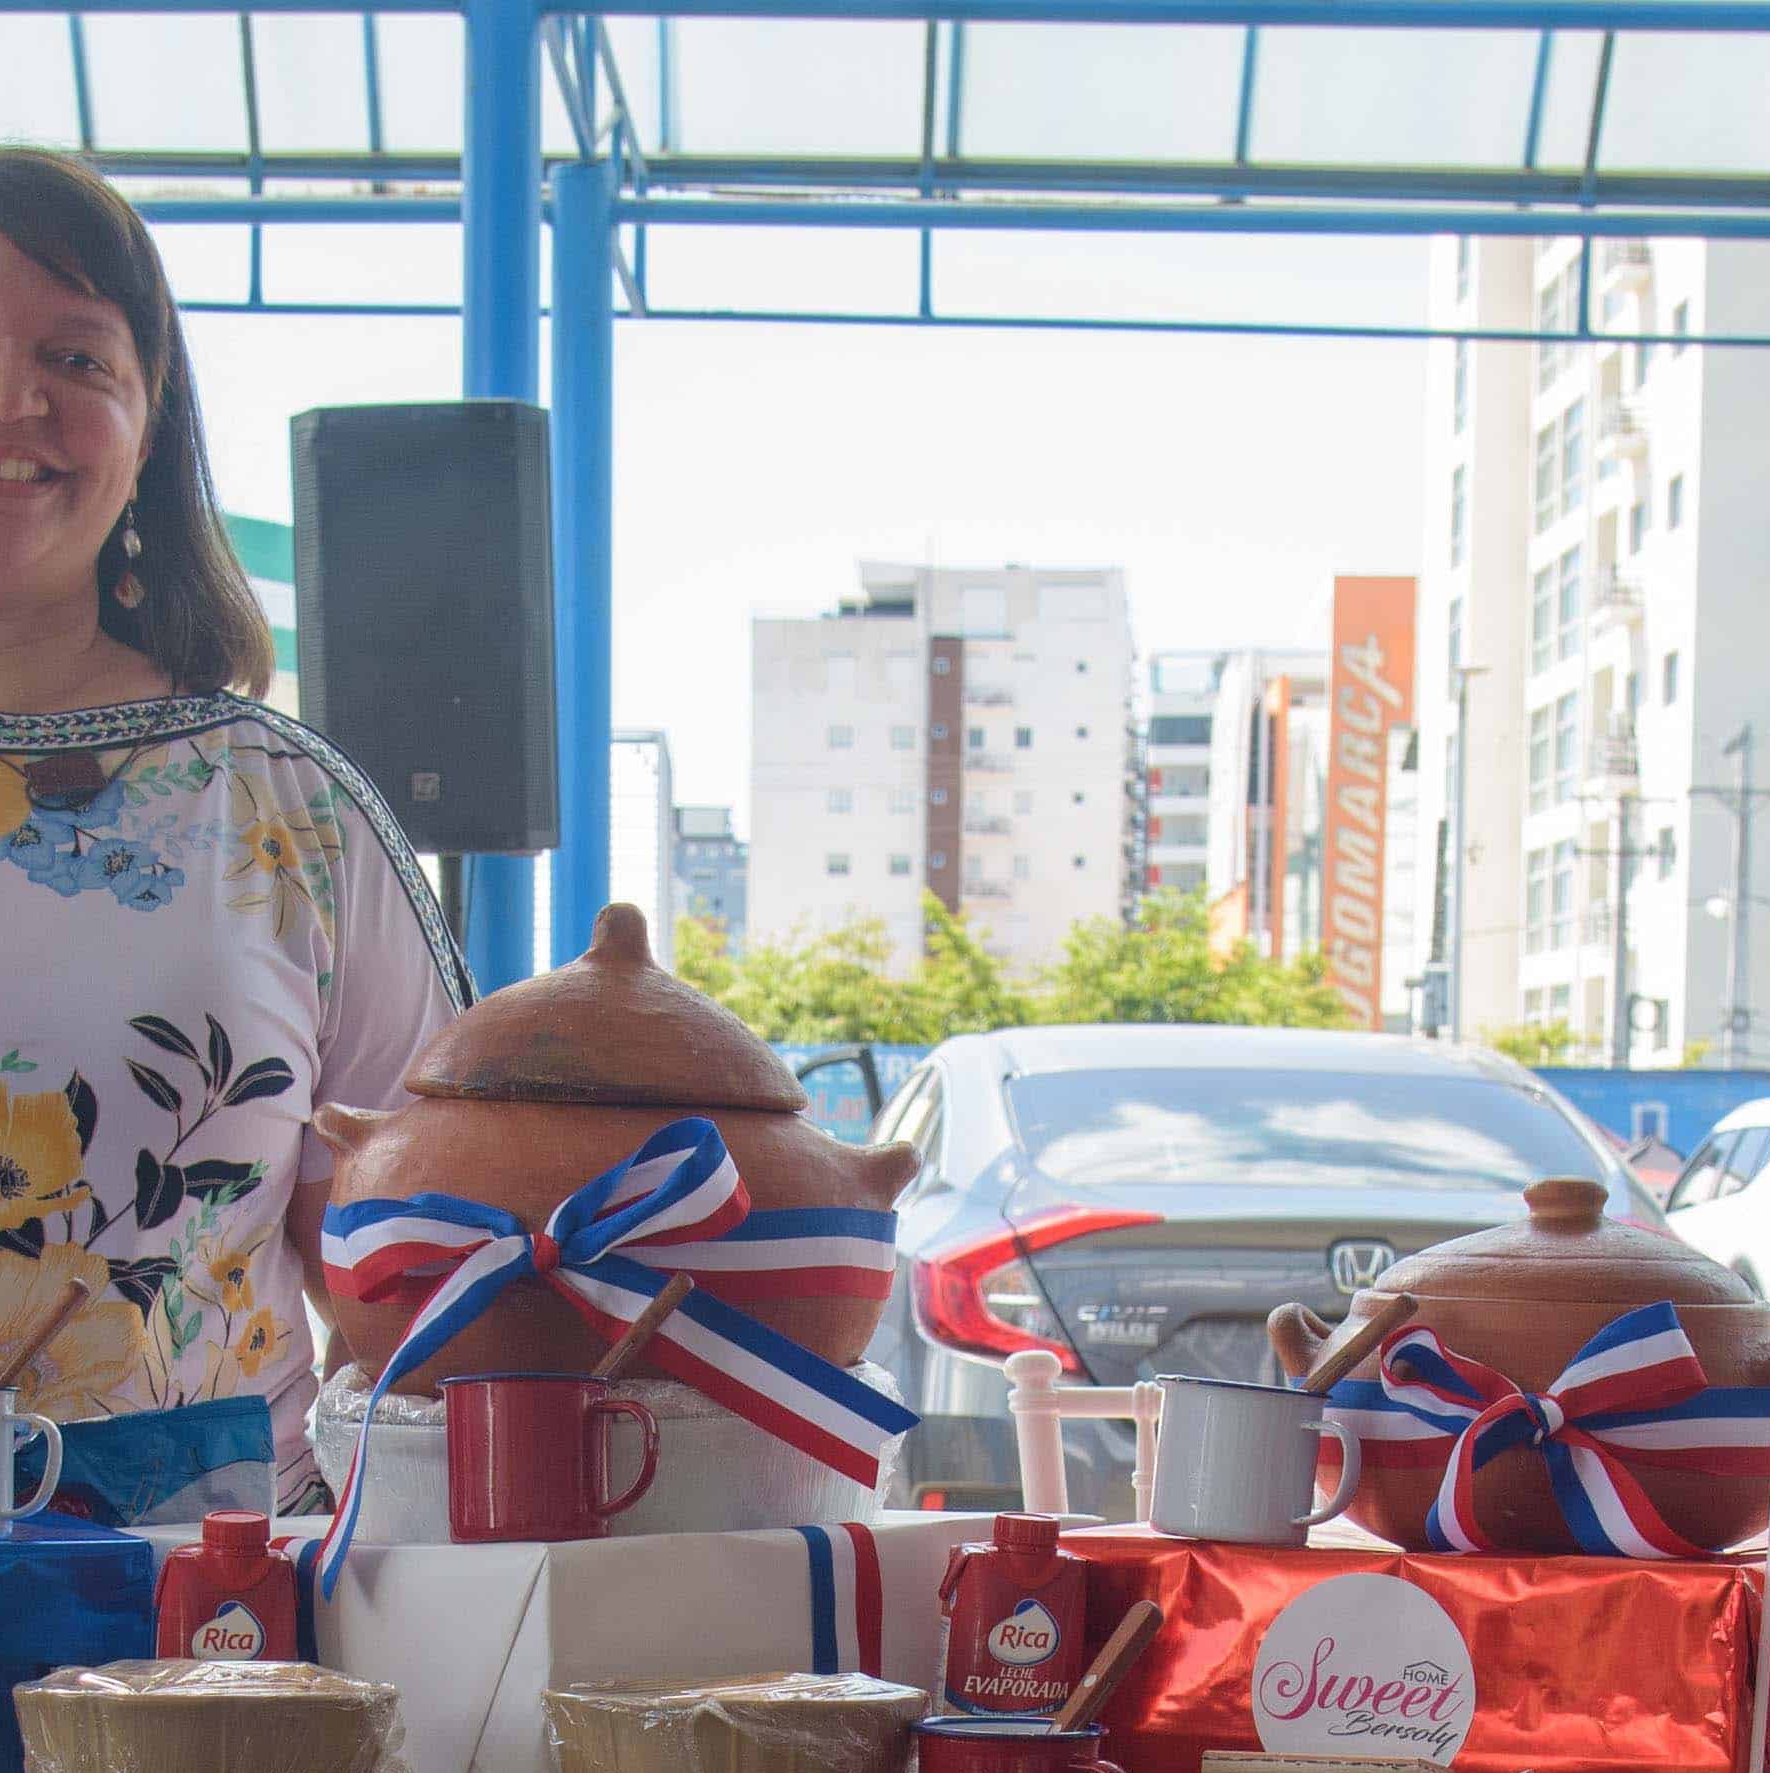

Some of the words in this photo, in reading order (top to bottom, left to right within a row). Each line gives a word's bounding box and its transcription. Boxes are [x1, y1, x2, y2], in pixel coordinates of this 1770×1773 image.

[203, 1627, 255, 1652] Rica
[999, 1624, 1050, 1650] Rica
[1000, 1666, 1036, 1679] LECHE
[1259, 1637, 1465, 1723] Sweet
[1402, 1668, 1450, 1686] HOME
[963, 1675, 1070, 1699] EVAPORADA
[1328, 1709, 1458, 1758] Bersoly
